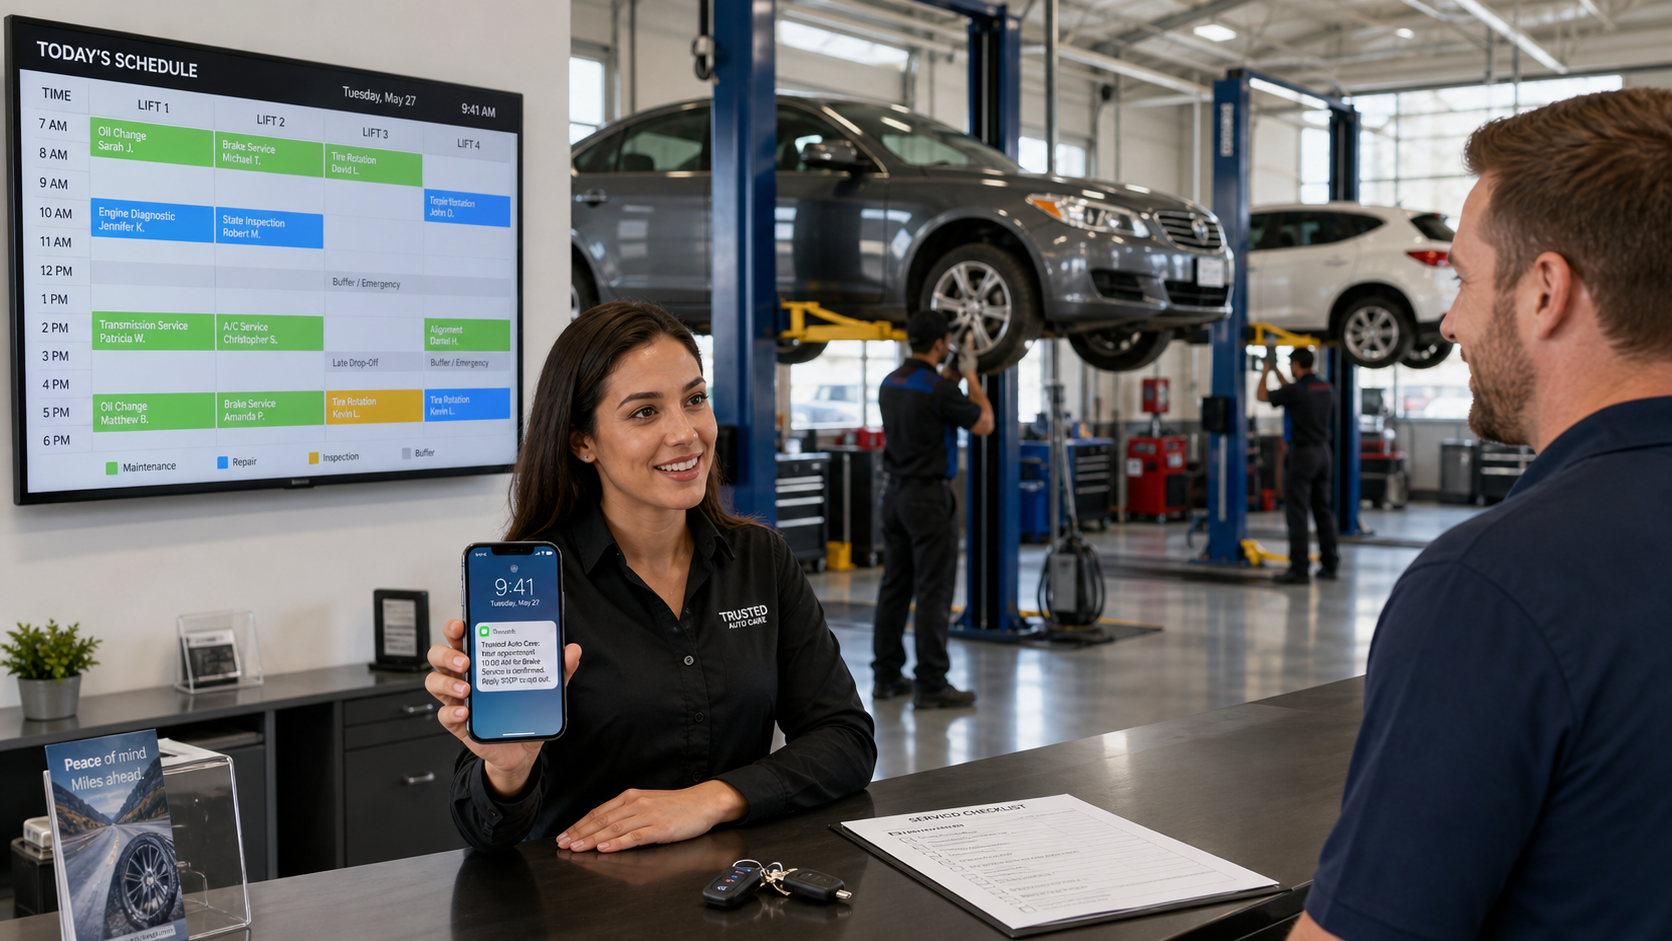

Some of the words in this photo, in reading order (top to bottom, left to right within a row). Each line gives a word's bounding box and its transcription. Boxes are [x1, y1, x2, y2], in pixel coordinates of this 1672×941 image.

[37, 40, 111, 66] TODAY'S
[115, 53, 198, 78] SCHEDULE
[42, 87, 71, 101] TIME
[342, 85, 383, 104] Tuesday,
[385, 92, 404, 107] May
[405, 95, 416, 106] 27
[138, 100, 161, 112] LIFT
[164, 103, 169, 113] 1
[461, 103, 479, 115] 9:41
[481, 107, 496, 118] AM
[38, 118, 46, 129] 7
[49, 120, 68, 131] AM
[257, 114, 277, 126] LIFT
[279, 118, 285, 127] 2
[98, 126, 111, 137] Oil
[113, 128, 147, 142] Change
[362, 127, 381, 138] LIFT
[382, 130, 389, 139] 3
[98, 141, 124, 152] Sarah
[126, 143, 134, 153] J.
[222, 140, 245, 150] Brake
[248, 143, 276, 154] Service
[457, 139, 473, 149] LIFT
[475, 141, 480, 150] 4
[39, 148, 47, 158] 8
[50, 149, 68, 160] AM
[222, 153, 252, 165] Michael
[254, 156, 261, 165] T.
[331, 152, 346, 162] Tire
[347, 153, 377, 164] Rotation
[353, 166, 360, 175] L.
[39, 177, 47, 188] 9
[50, 178, 68, 190] AM
[39, 207, 51, 218] 10
[54, 208, 72, 219] AM
[99, 207, 129, 219] Engine
[131, 209, 176, 222] Diagnostic
[429, 208, 446, 217] John
[447, 209, 455, 218] D.
[98, 221, 134, 232] Jennifer
[136, 223, 145, 232] K.
[223, 215, 243, 225] State
[246, 217, 285, 228] Inspection
[223, 228, 249, 238] Robert
[251, 230, 261, 239] M.
[40, 236, 50, 247] 11
[54, 237, 72, 248] AM
[41, 265, 52, 276] 12
[55, 266, 72, 276] PM
[332, 278, 355, 287] Buffer
[362, 279, 401, 290] Emergency
[42, 294, 47, 304] 1
[50, 294, 68, 304] PM
[42, 322, 49, 333] 2
[52, 323, 68, 333] PM
[100, 320, 156, 330] Transmission
[158, 321, 188, 330] Service
[223, 322, 239, 331] A/C
[240, 322, 268, 331] Service
[100, 333, 132, 343] Patricia
[134, 334, 145, 343] W.
[223, 335, 268, 346] Christopher
[269, 336, 278, 344] S.
[42, 351, 49, 361] 3
[52, 351, 69, 361] PM
[332, 358, 348, 367] Late
[350, 359, 378, 368] Drop-Off
[430, 359, 450, 367] Buffer
[456, 359, 489, 368] Emergency
[42, 379, 49, 389] 4
[52, 379, 69, 389] PM
[224, 399, 246, 409] Brake
[248, 399, 276, 408] Service
[348, 397, 377, 406] Rotation
[43, 407, 50, 418] 5
[53, 408, 70, 418] PM
[101, 402, 113, 412] Oil
[115, 402, 148, 413] Change
[224, 412, 256, 421] Amanda
[258, 412, 265, 421] P.
[353, 410, 360, 418] L.
[101, 416, 138, 425] Matthew
[140, 415, 149, 424] B.
[43, 436, 50, 446] 6
[53, 435, 70, 445] PM
[323, 452, 360, 463] Inspection
[415, 448, 435, 457] Buffer
[123, 462, 177, 472] Maintenance
[233, 457, 257, 468] Repair
[495, 578, 533, 596] 9:41
[719, 605, 768, 622] TRUSTED
[729, 621, 747, 629] AUTO
[64, 756, 101, 771] Peace
[104, 750, 116, 765] of
[119, 746, 147, 762] mind
[71, 775, 103, 791] Miles
[106, 767, 144, 785] ahead.
[963, 804, 1026, 816] CHECKLIST
